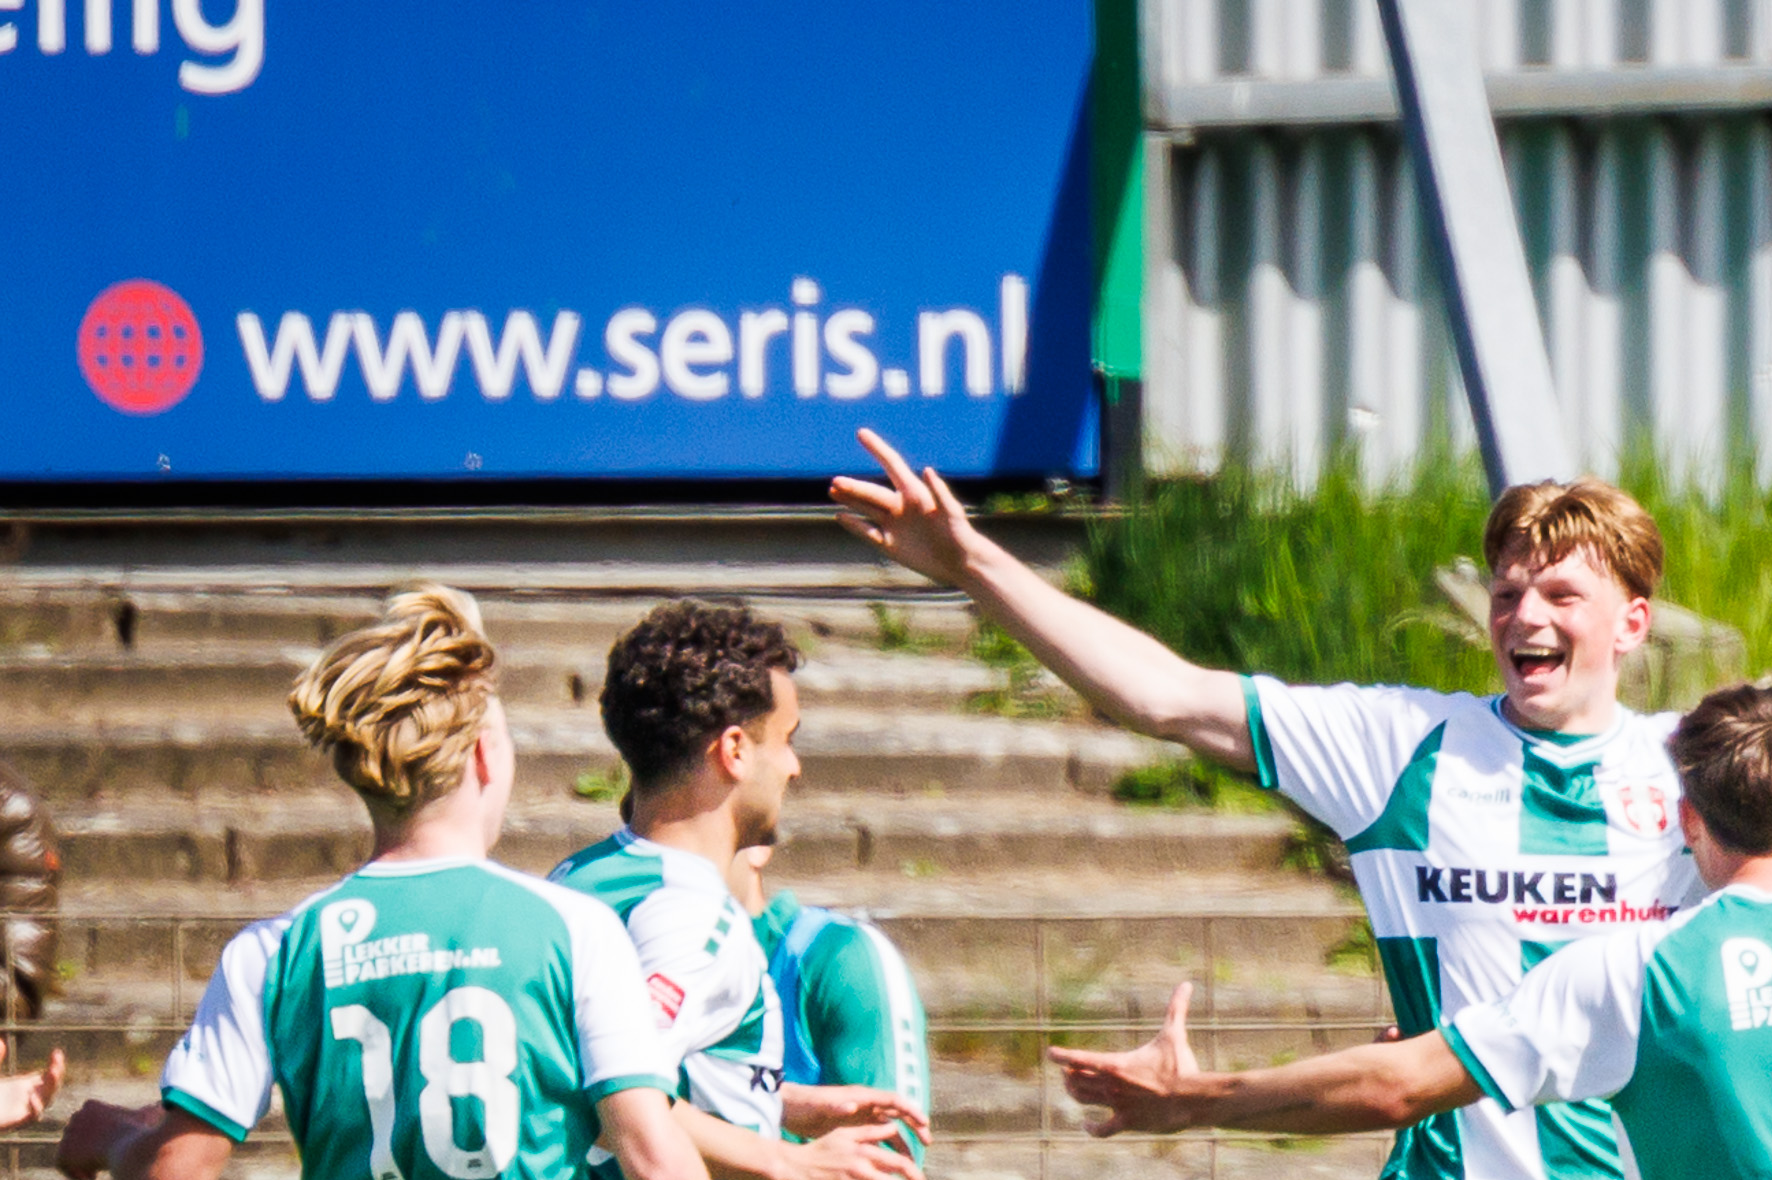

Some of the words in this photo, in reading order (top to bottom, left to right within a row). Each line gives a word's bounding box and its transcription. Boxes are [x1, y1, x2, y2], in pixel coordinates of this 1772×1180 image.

[236, 274, 1028, 402] www.seris.nl
[1415, 865, 1616, 904] KEUKEN
[343, 932, 429, 964] LEKKER
